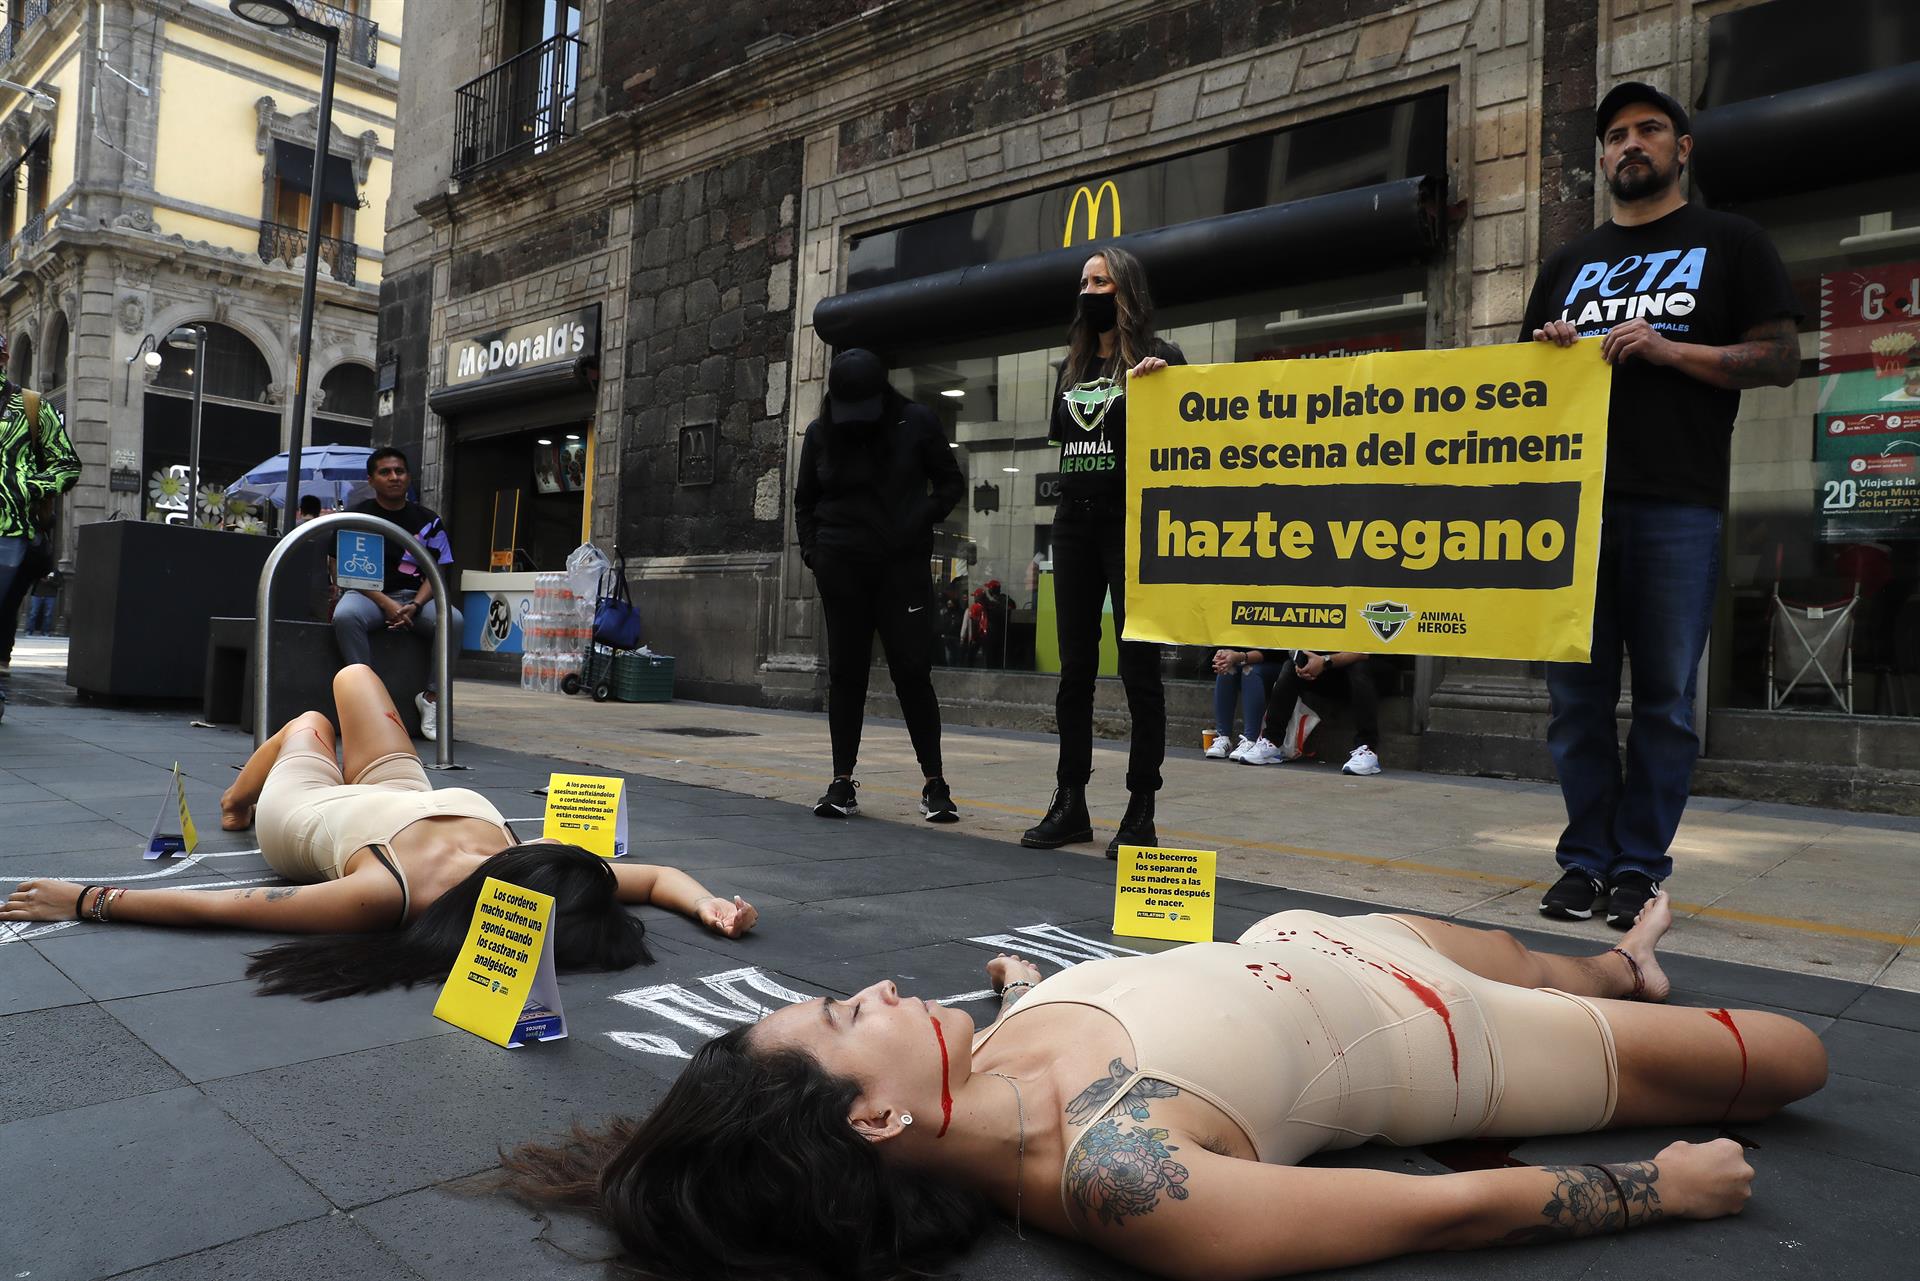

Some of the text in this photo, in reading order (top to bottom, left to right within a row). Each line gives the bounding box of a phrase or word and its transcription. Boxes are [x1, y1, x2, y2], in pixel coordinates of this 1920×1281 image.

[1560, 292, 1696, 328] LATINO
[457, 322, 585, 378] McDonald's
[1179, 380, 1548, 425] Que tu plato no sea
[1063, 440, 1114, 457] ANIMAL
[1150, 430, 1583, 473] una escena del crimen:
[1060, 455, 1116, 475] HEROES
[1859, 478, 1894, 489] Viajes
[1905, 477, 1916, 486] la
[1823, 479, 1857, 509] 20
[1859, 489, 1888, 499] Copa
[1858, 499, 1872, 508] de
[1873, 499, 1883, 508] la
[1885, 498, 1911, 508] FIFA
[356, 536, 366, 552] E
[1157, 510, 1565, 570] hazte vegano
[1420, 611, 1465, 622] ANIMAL
[1417, 622, 1467, 634] HEROES
[550, 803, 578, 812] branquias
[578, 805, 603, 813] mientras
[564, 797, 597, 805] cortándoles
[572, 813, 606, 821] conscientes.
[1145, 852, 1158, 860] los
[1159, 853, 1198, 863] becerros
[1135, 863, 1198, 874] los separan de
[1147, 876, 1180, 885] madres
[1188, 877, 1201, 886] las
[1120, 886, 1210, 898] pocas horas después
[493, 888, 538, 912] Los corderos
[1145, 898, 1184, 908] de nacer.
[480, 903, 542, 932] macho sufren una
[480, 920, 533, 947] agonía cuando
[476, 934, 528, 964] los castran sin
[474, 954, 518, 978] analgésicos
[525, 1024, 547, 1032] blancos
